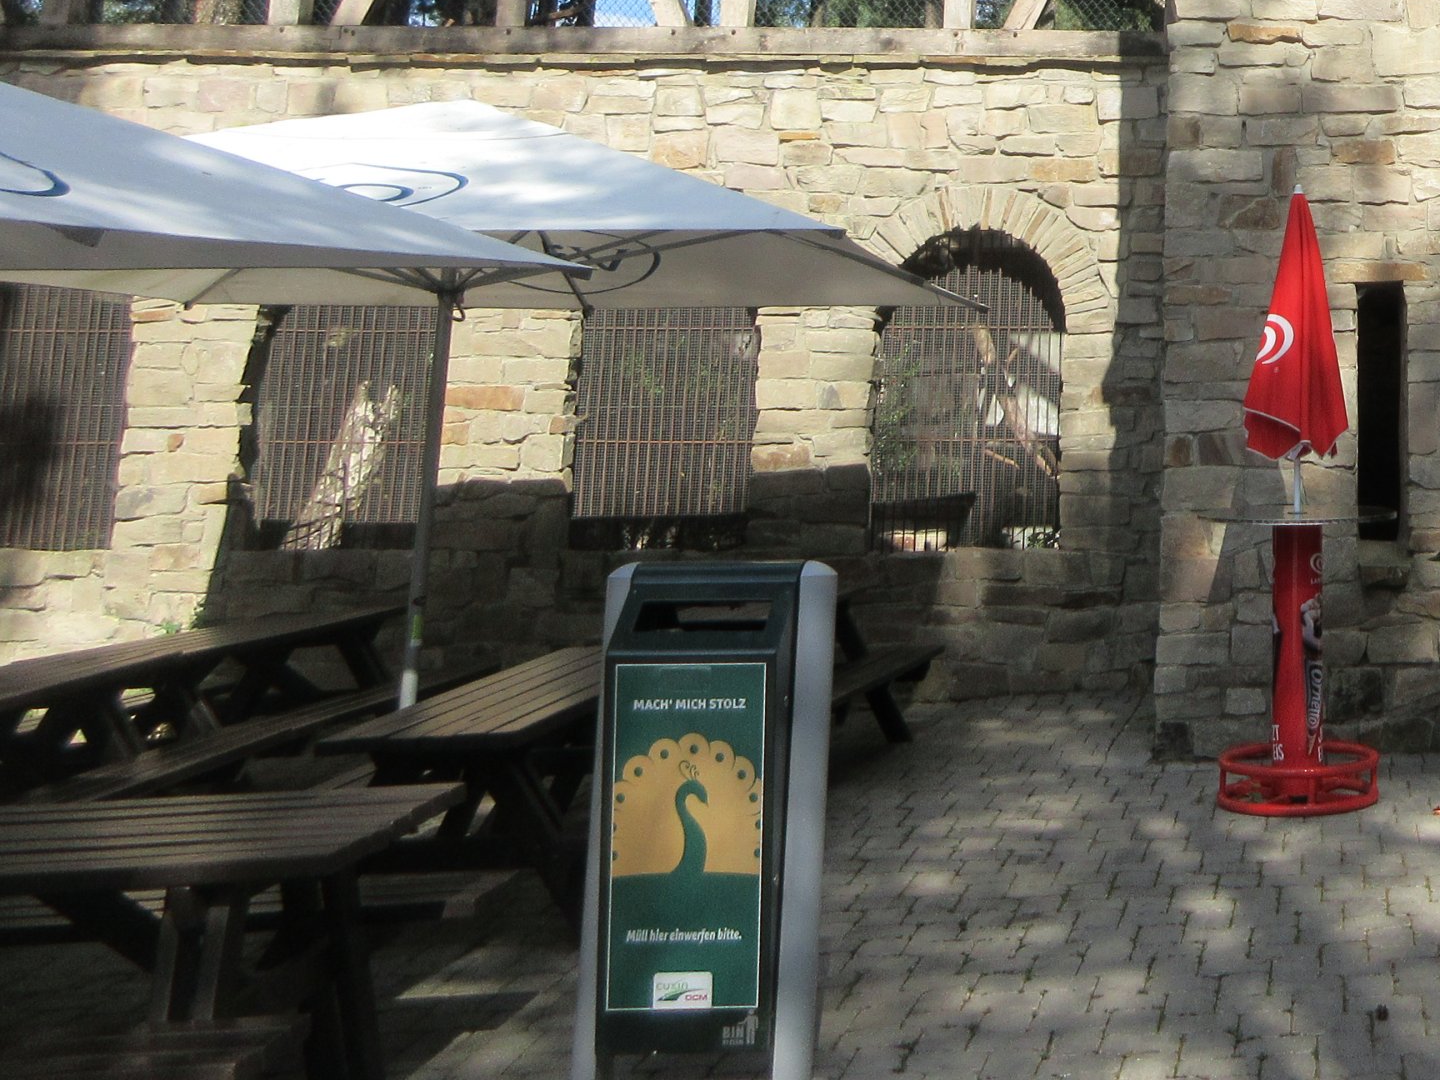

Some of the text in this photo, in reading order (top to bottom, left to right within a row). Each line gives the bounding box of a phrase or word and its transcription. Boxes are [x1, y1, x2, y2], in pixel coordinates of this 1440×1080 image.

[633, 698, 746, 710] MACH' MICH STOLZ
[626, 927, 742, 944] Müll hier einwerfen bitte.
[722, 1026, 744, 1038] BIN
